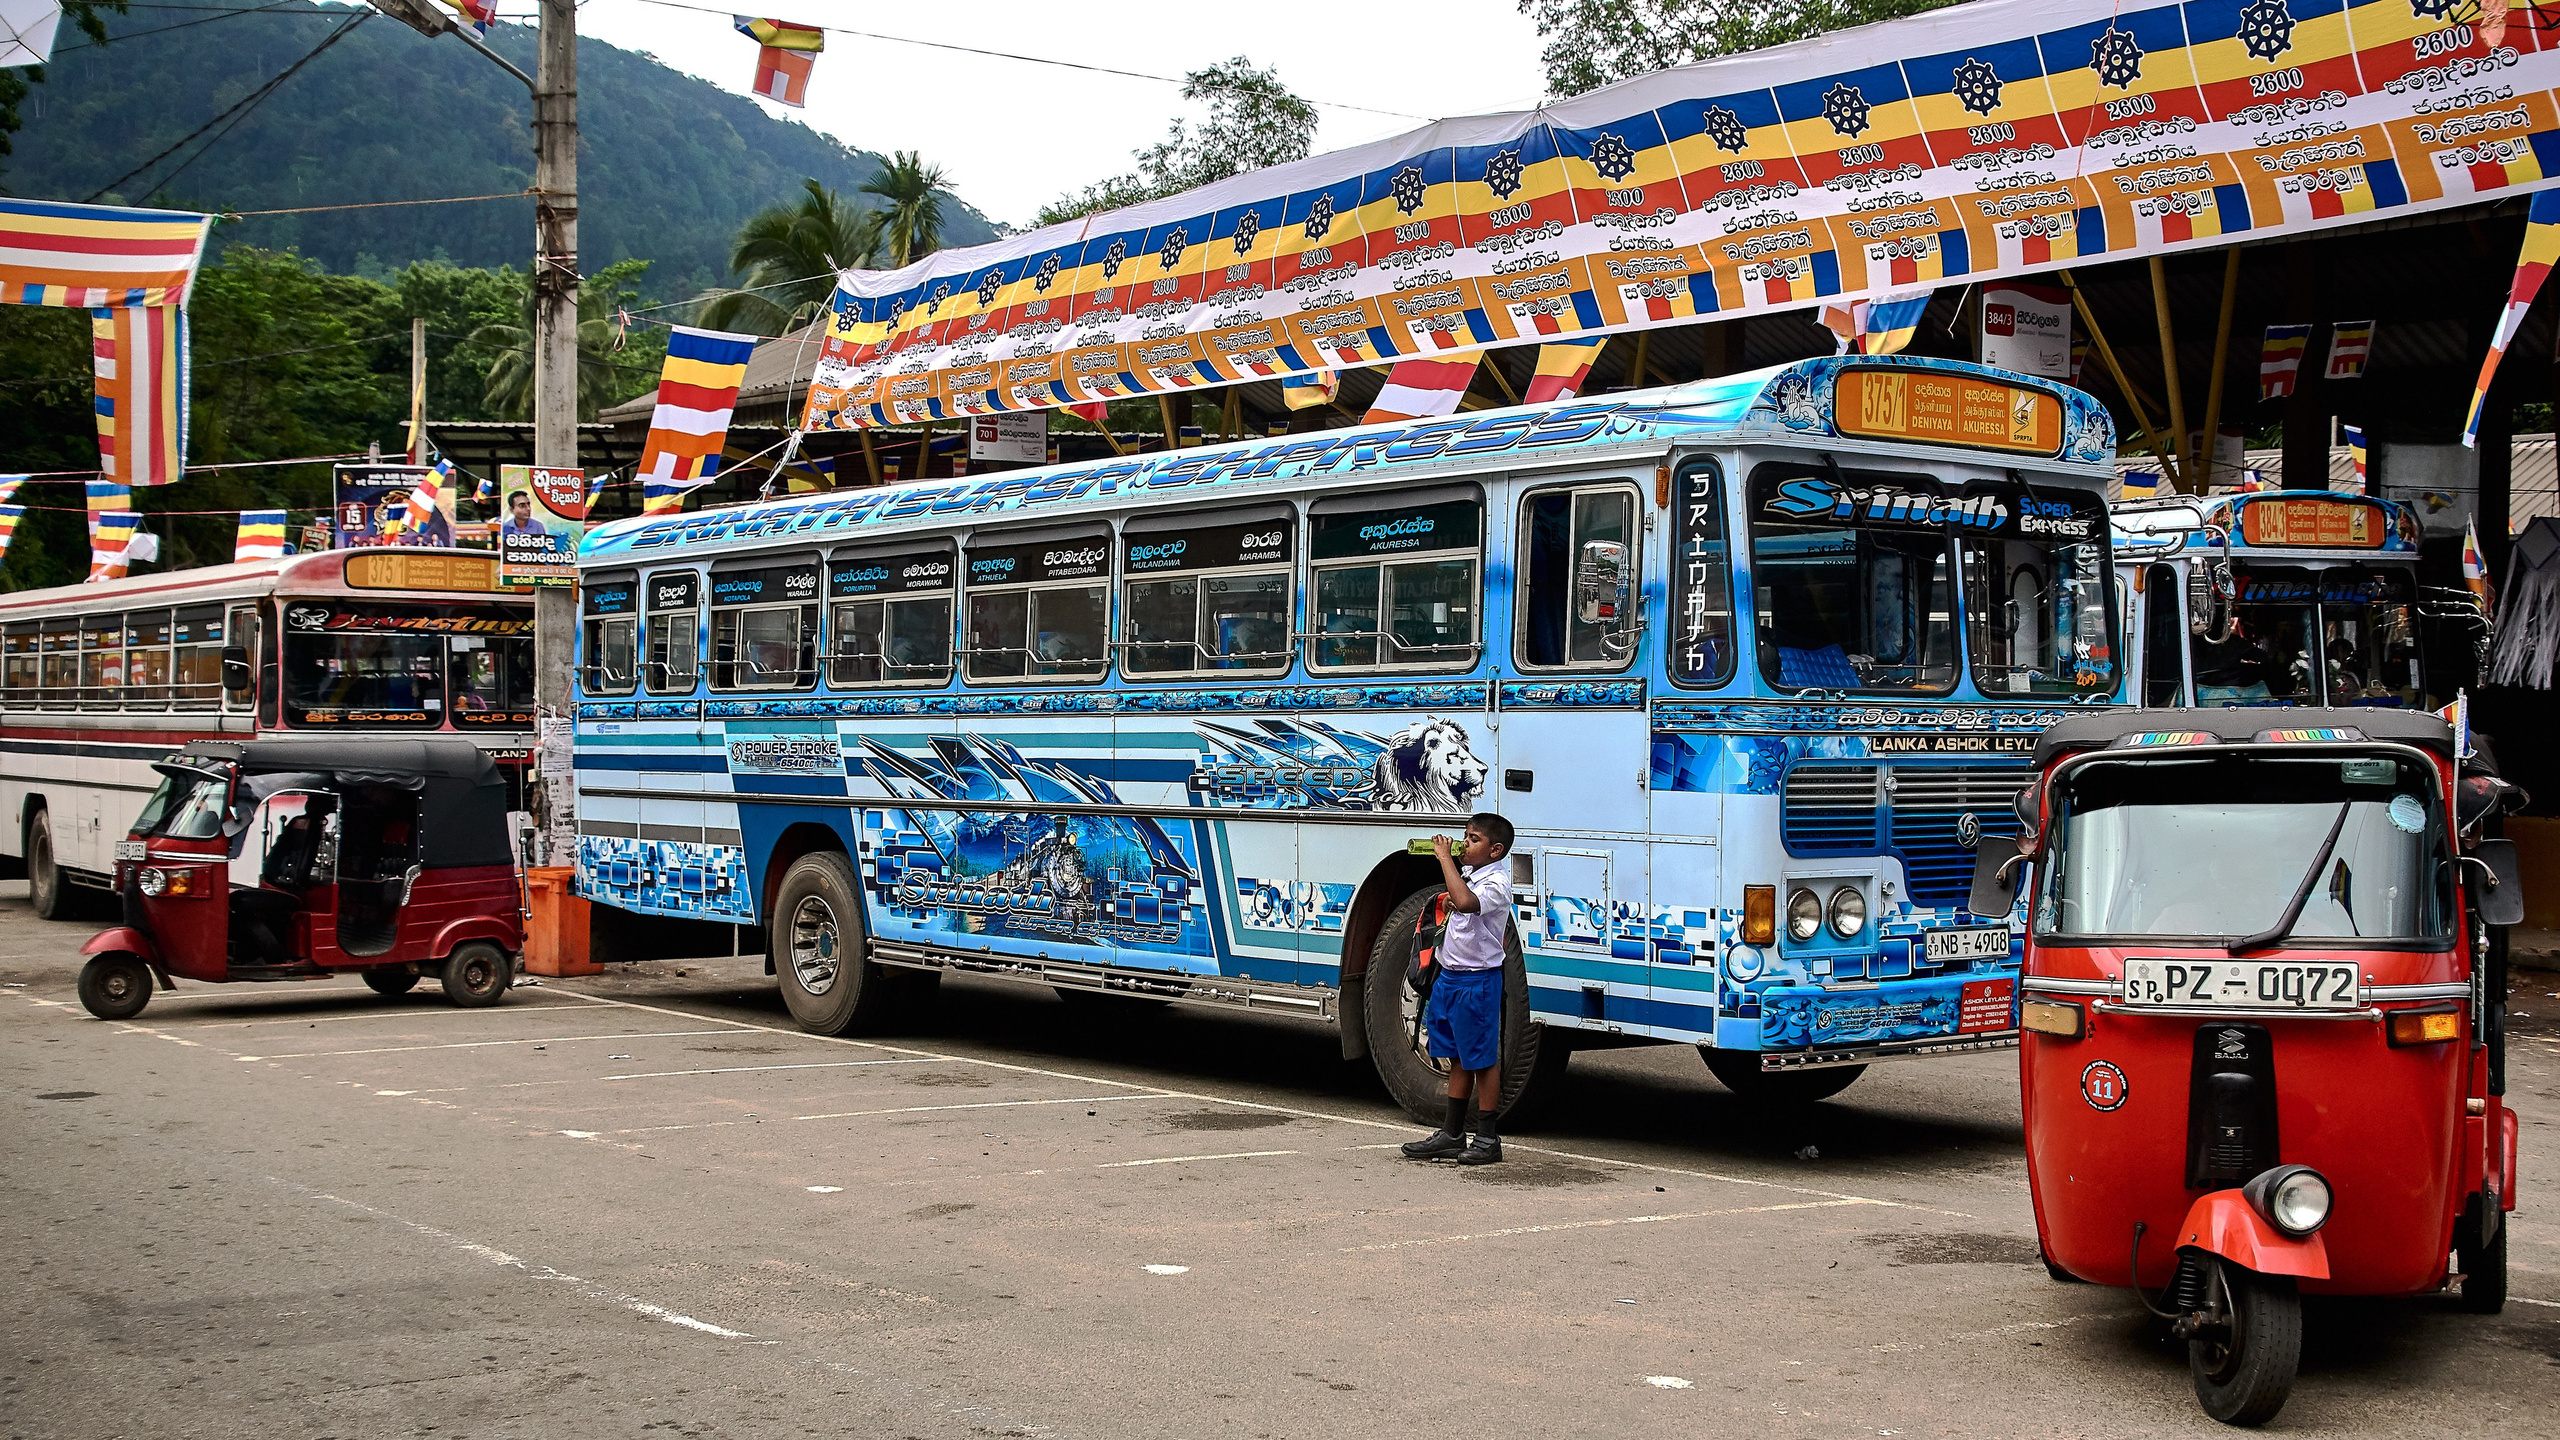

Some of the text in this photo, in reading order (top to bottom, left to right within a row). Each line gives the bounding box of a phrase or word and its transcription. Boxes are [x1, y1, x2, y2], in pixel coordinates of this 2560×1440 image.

[2413, 25, 2473, 59] 2600
[2250, 69, 2303, 97] 2600
[2105, 94, 2156, 121] 2600
[2412, 85, 2514, 115] ජයන්තිය
[1968, 122, 2016, 146] 2600
[2254, 120, 2348, 147] ජයන්තිය
[2111, 144, 2197, 168] ජයන්තිය
[1721, 160, 1765, 183] 2600
[1975, 171, 2056, 193] ජයන්තිය
[1490, 202, 1533, 229] 2600
[1722, 210, 1798, 234] ජයන්තිය
[1300, 247, 1333, 269] 2600
[1492, 250, 1560, 276] ජයන්තිය
[1152, 277, 1179, 294] 2600
[1299, 289, 1354, 311] ජයන්තිය
[1987, 311, 2012, 326] 384/3
[1864, 372, 1906, 428] 375/1
[1914, 383, 1952, 398] දෙනියාය
[980, 429, 993, 439] 701
[1912, 416, 2005, 436] DENIYAYA AKURESSA
[2013, 434, 2033, 443] SPRPTA
[630, 490, 885, 546] SRINATH
[882, 462, 1140, 516] SUPER
[1764, 476, 2008, 533] Srinath
[345, 509, 360, 525] 15
[506, 534, 556, 551] මහින්ද
[1130, 540, 1187, 561] හුලංදාව
[1370, 539, 1420, 550] AKURESSA
[507, 551, 576, 563] පනාගොඩ
[1042, 547, 1106, 567] පිටබැද්දර
[1132, 550, 1282, 569] HULANDAWA MARAMBA
[902, 562, 949, 578] මොරවක
[977, 566, 1097, 582] ATHUELA PITABEDDARA
[409, 578, 486, 588] AKURESSA DENIYAYA
[658, 584, 688, 599] දියදාව
[714, 573, 817, 594] කොටපොල වරල්ල
[842, 578, 942, 593] PORUPITIYA MORAWAKA
[594, 591, 628, 604] දෙනියාය
[659, 599, 684, 607] DIYADAWA
[723, 589, 813, 602] KOTAPOLA WARALLA
[1526, 690, 1561, 700] star
[347, 712, 427, 721] සරණයි
[1839, 708, 1910, 726] සම්මා
[745, 742, 837, 755] POWER STROKE
[1873, 737, 1930, 751] LANKA
[1935, 737, 1989, 751] ASHOK
[1217, 766, 1364, 788] SPEED
[1338, 778, 1418, 804] Lion
[897, 868, 1056, 918] Srinath
[1005, 915, 1075, 934] SUPER
[1941, 934, 1958, 955] NB
[1974, 931, 2007, 952] 4908
[2165, 964, 2213, 1001] PZ
[2258, 965, 2354, 1002] 0072
[1835, 1003, 1922, 1019] POWER STROKE
[2092, 1079, 2114, 1100] 11
